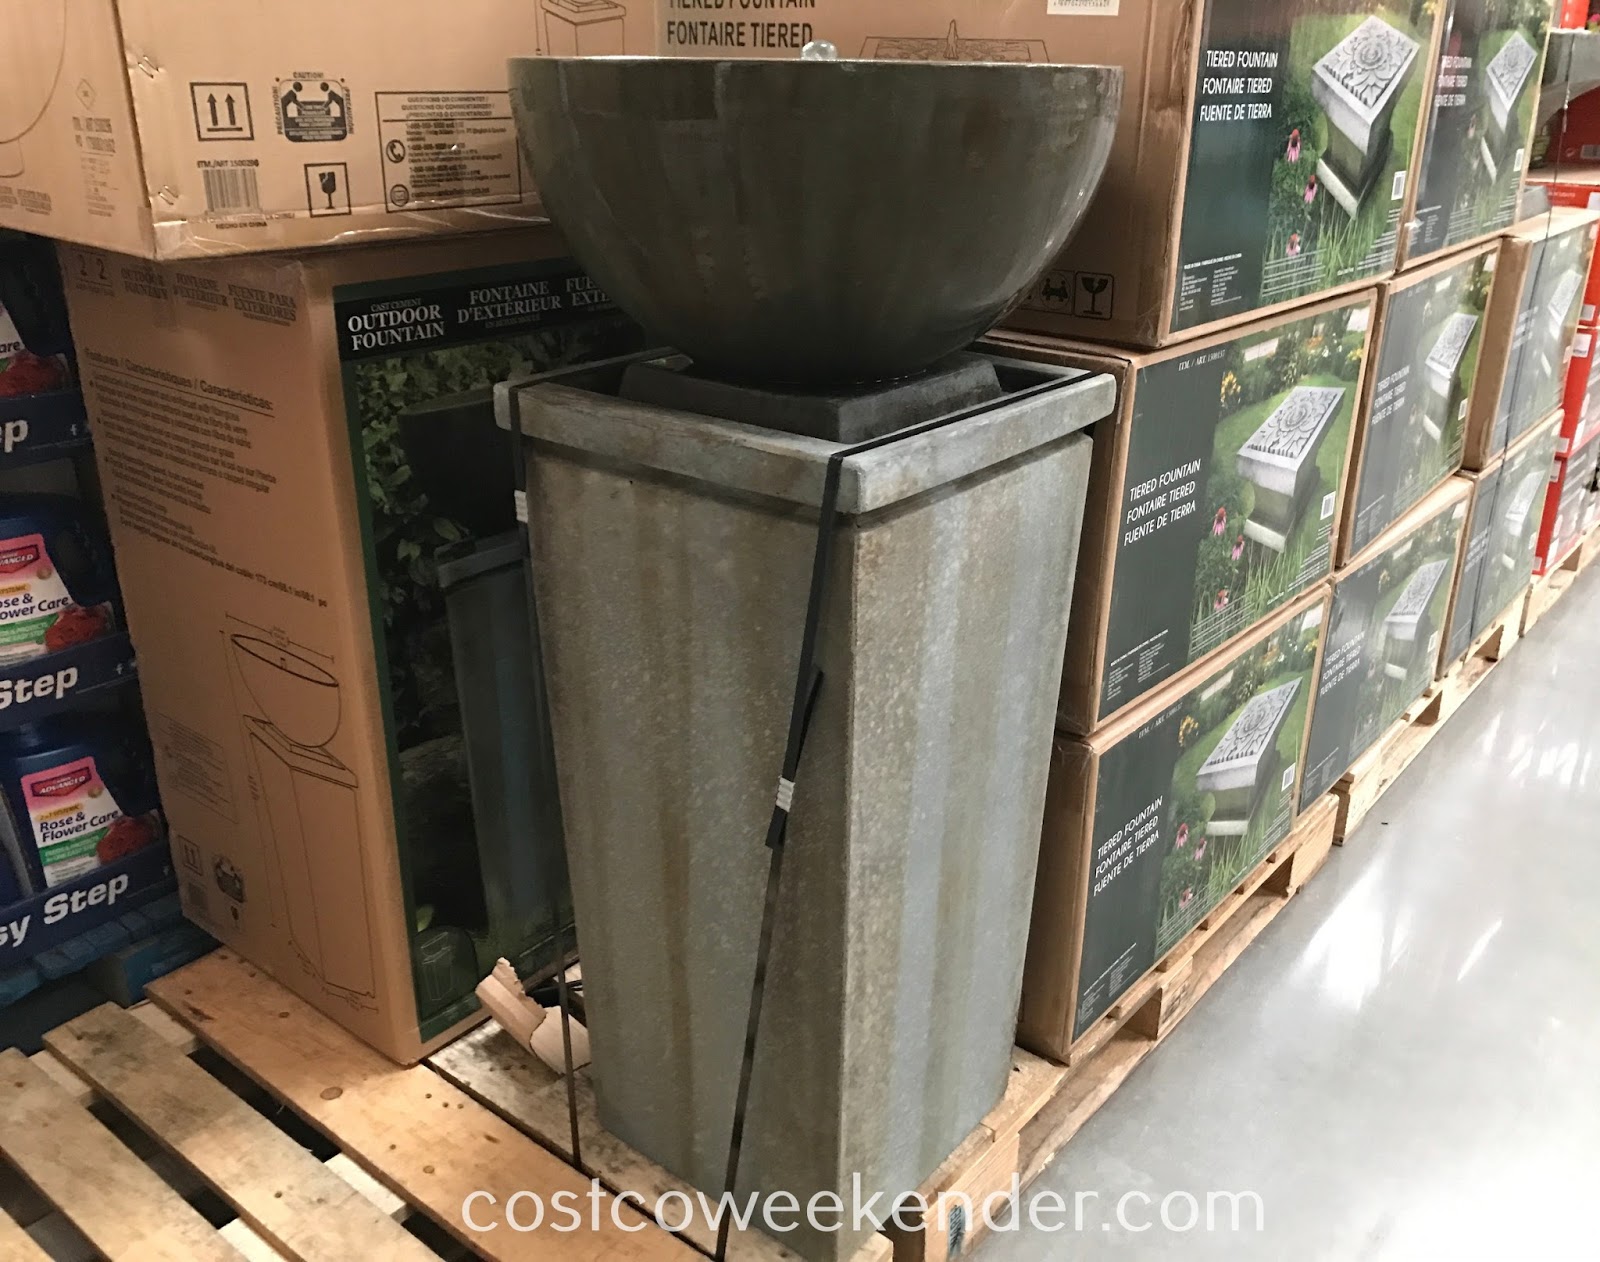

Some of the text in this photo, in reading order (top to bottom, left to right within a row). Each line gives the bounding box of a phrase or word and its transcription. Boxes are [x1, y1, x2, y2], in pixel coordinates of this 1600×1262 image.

[667, 21, 813, 48] FONTAIRE TIERED
[1206, 50, 1279, 68] TIERED FOUNTAIN
[1202, 77, 1273, 94] FONTAIRE TIERED
[1199, 103, 1272, 121] FUENTE DE TIERRA
[469, 280, 550, 305] FONTAINE
[347, 304, 442, 333] OUTDOOR
[352, 320, 445, 351] FOUNTAIN
[1130, 458, 1201, 502] TIERED FOUNTAIN
[1126, 480, 1196, 524] FONTAIRE TIERED
[1123, 500, 1196, 546] FUENTE DE TIERRA
[22, 592, 34, 604] &
[37, 596, 69, 612] Care
[40, 811, 87, 833] Rose &
[42, 810, 119, 843] Flower Care
[1097, 795, 1163, 860] TIERED FOUNTAIN
[1095, 815, 1159, 879] FONTAIRE TIERED
[1093, 829, 1160, 897] FUENTE DE TIERRA
[43, 873, 129, 925] Step
